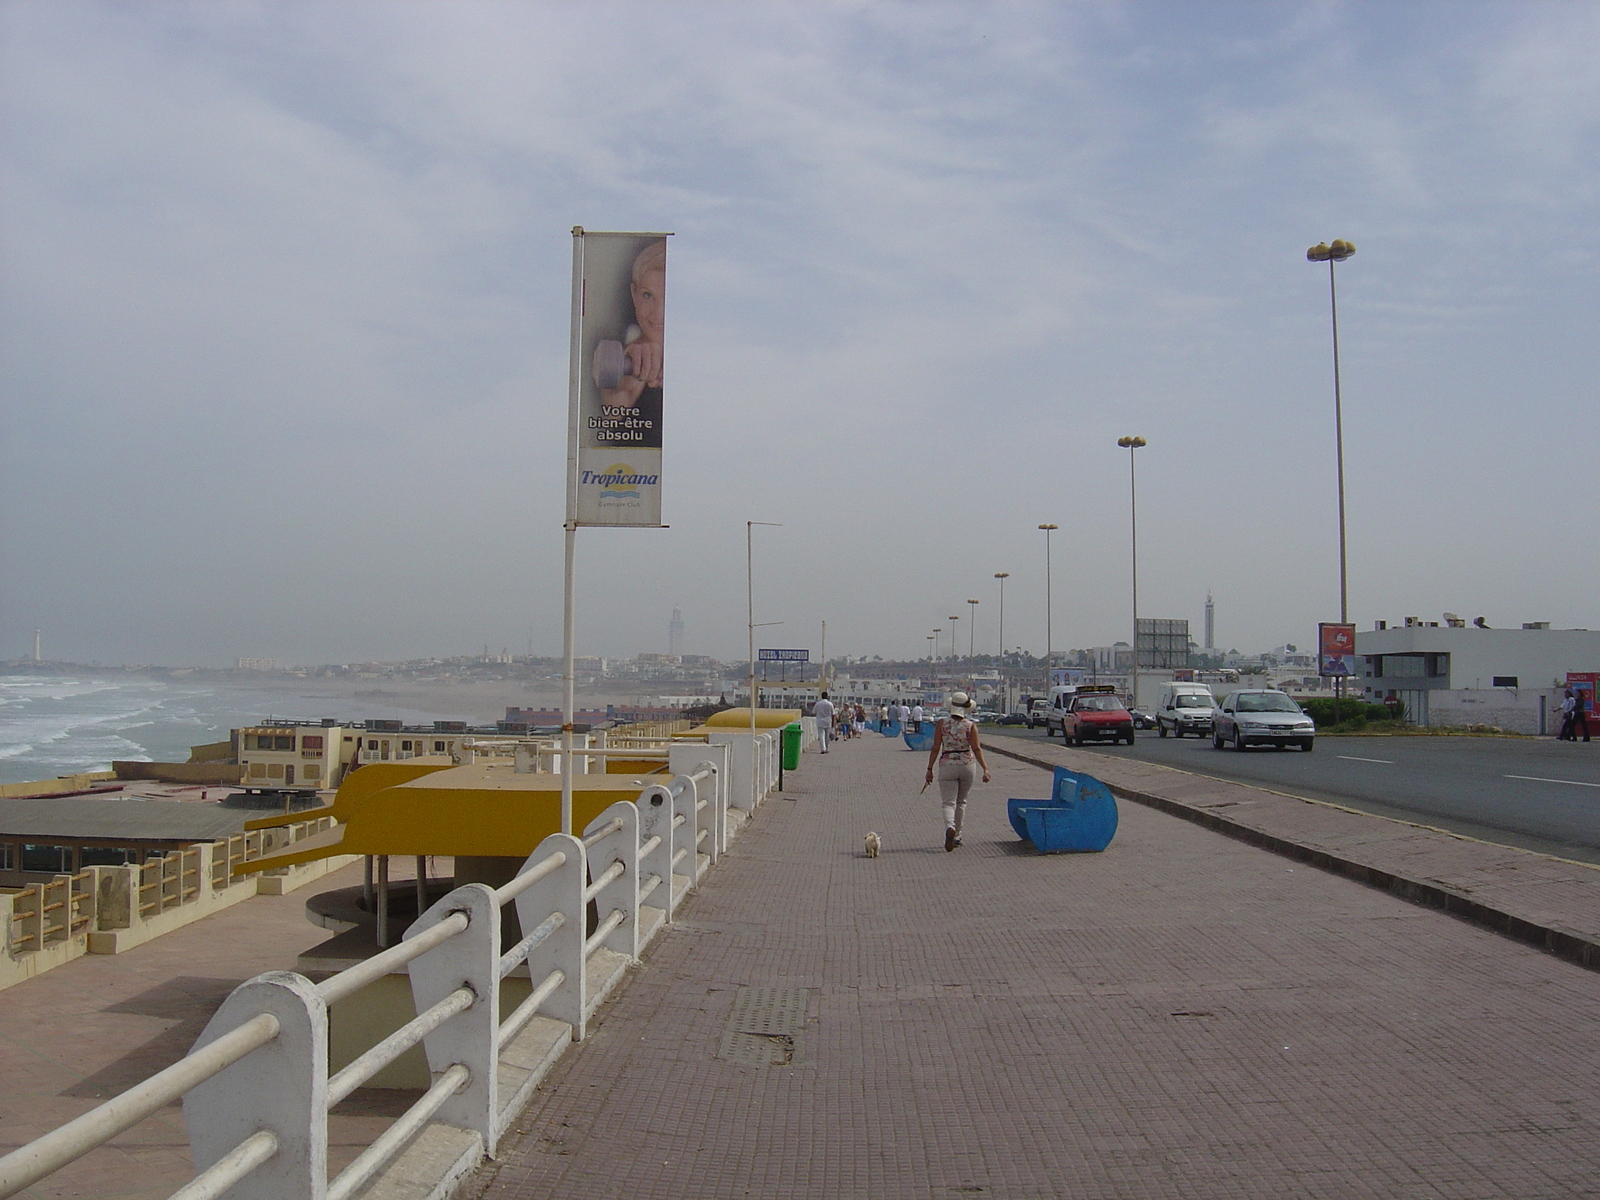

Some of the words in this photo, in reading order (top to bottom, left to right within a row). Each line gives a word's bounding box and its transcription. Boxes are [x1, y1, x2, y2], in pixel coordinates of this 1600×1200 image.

[602, 405, 640, 416] Votre
[589, 417, 653, 429] bien-être
[597, 430, 643, 441] absolu
[582, 469, 658, 488] Tropicana
